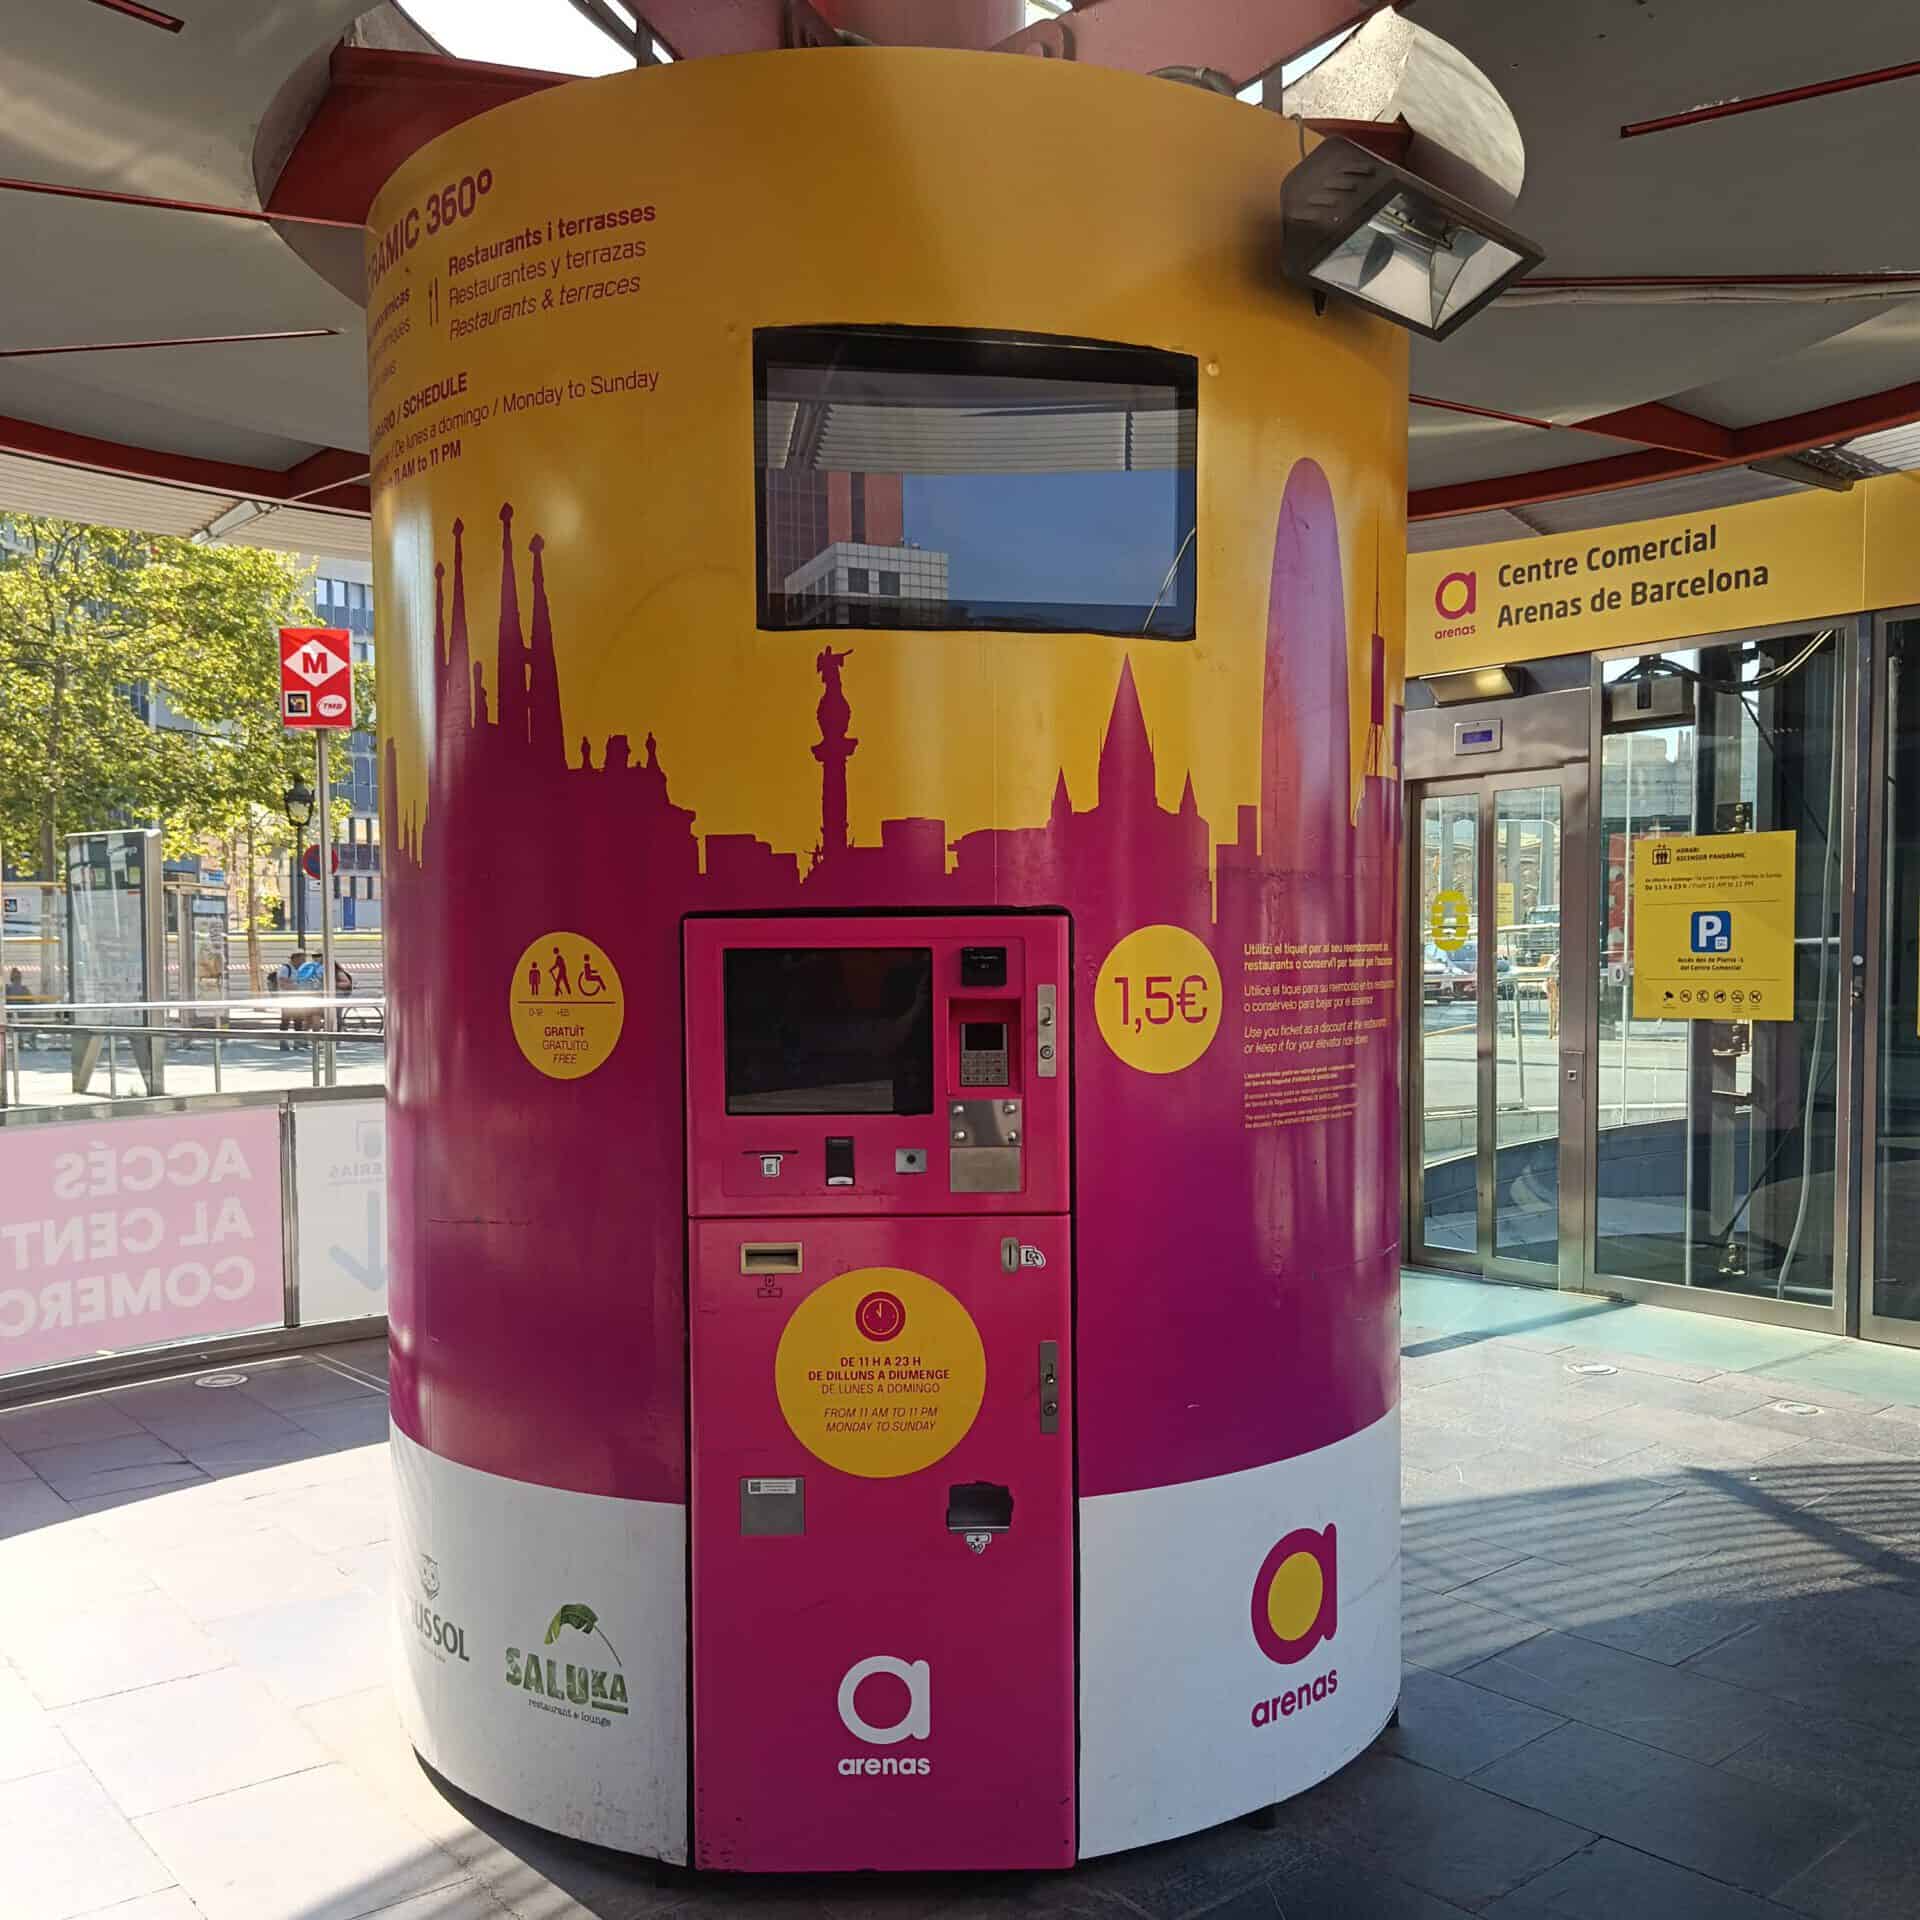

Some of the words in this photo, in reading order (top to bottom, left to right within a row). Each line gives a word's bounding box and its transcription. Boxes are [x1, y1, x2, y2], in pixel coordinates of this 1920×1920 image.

[448, 228, 543, 277] Restaurants
[547, 221, 553, 241] i
[557, 204, 656, 239] terrasses
[448, 260, 547, 307] Restaurantes
[550, 256, 561, 279] y
[565, 240, 647, 270] terrazas
[449, 295, 537, 340] Restaurants
[541, 287, 555, 310] &
[559, 275, 641, 306] terraces
[402, 371, 468, 418] SCHEDULE
[438, 404, 490, 435] domingo
[503, 384, 564, 414] Monday
[567, 379, 586, 400] to
[590, 369, 660, 396] Sunday
[402, 457, 416, 481] AM
[417, 455, 428, 472] to
[430, 447, 440, 466] 11
[441, 439, 461, 462] PM
[1498, 554, 1579, 588] Centre
[1586, 524, 1718, 572] Comercial
[1497, 593, 1583, 629] Arenas
[1590, 587, 1622, 613] de
[1631, 564, 1770, 607] Barcelona
[1434, 623, 1477, 641] arenas
[302, 652, 328, 674] M
[1698, 915, 1723, 948] P
[1244, 959, 1294, 971] restaurants
[1114, 975, 1208, 1034] 1,5€
[552, 1053, 577, 1064] FREE
[808, 1370, 824, 1382] DE
[826, 1370, 874, 1381] DILLUNS
[877, 1370, 886, 1381] A
[888, 1369, 951, 1380] DIUMENGE
[840, 1356, 855, 1367] DE
[859, 1356, 870, 1366] 11
[871, 1356, 881, 1366] H
[884, 1356, 892, 1366] A
[895, 1355, 911, 1367] 23
[912, 1355, 922, 1366] H
[821, 1384, 835, 1395] DE
[838, 1384, 874, 1394] LUNES
[877, 1383, 884, 1393] A
[887, 1382, 941, 1393] DOMINGO
[823, 1407, 857, 1418] FROM
[858, 1407, 870, 1418] 11
[870, 1407, 890, 1418] AM
[892, 1407, 907, 1418] TO
[909, 1406, 920, 1417] 11
[921, 1406, 939, 1417] PM
[825, 1422, 873, 1433] MONDAY
[876, 1421, 891, 1432] TO
[892, 1420, 937, 1432] SUNDAY
[411, 1599, 470, 1663] USSOL
[505, 1647, 628, 1705] SALUKA
[528, 1698, 572, 1719] restaurant
[1250, 1668, 1338, 1728] arenas
[837, 1757, 932, 1776] arenas
